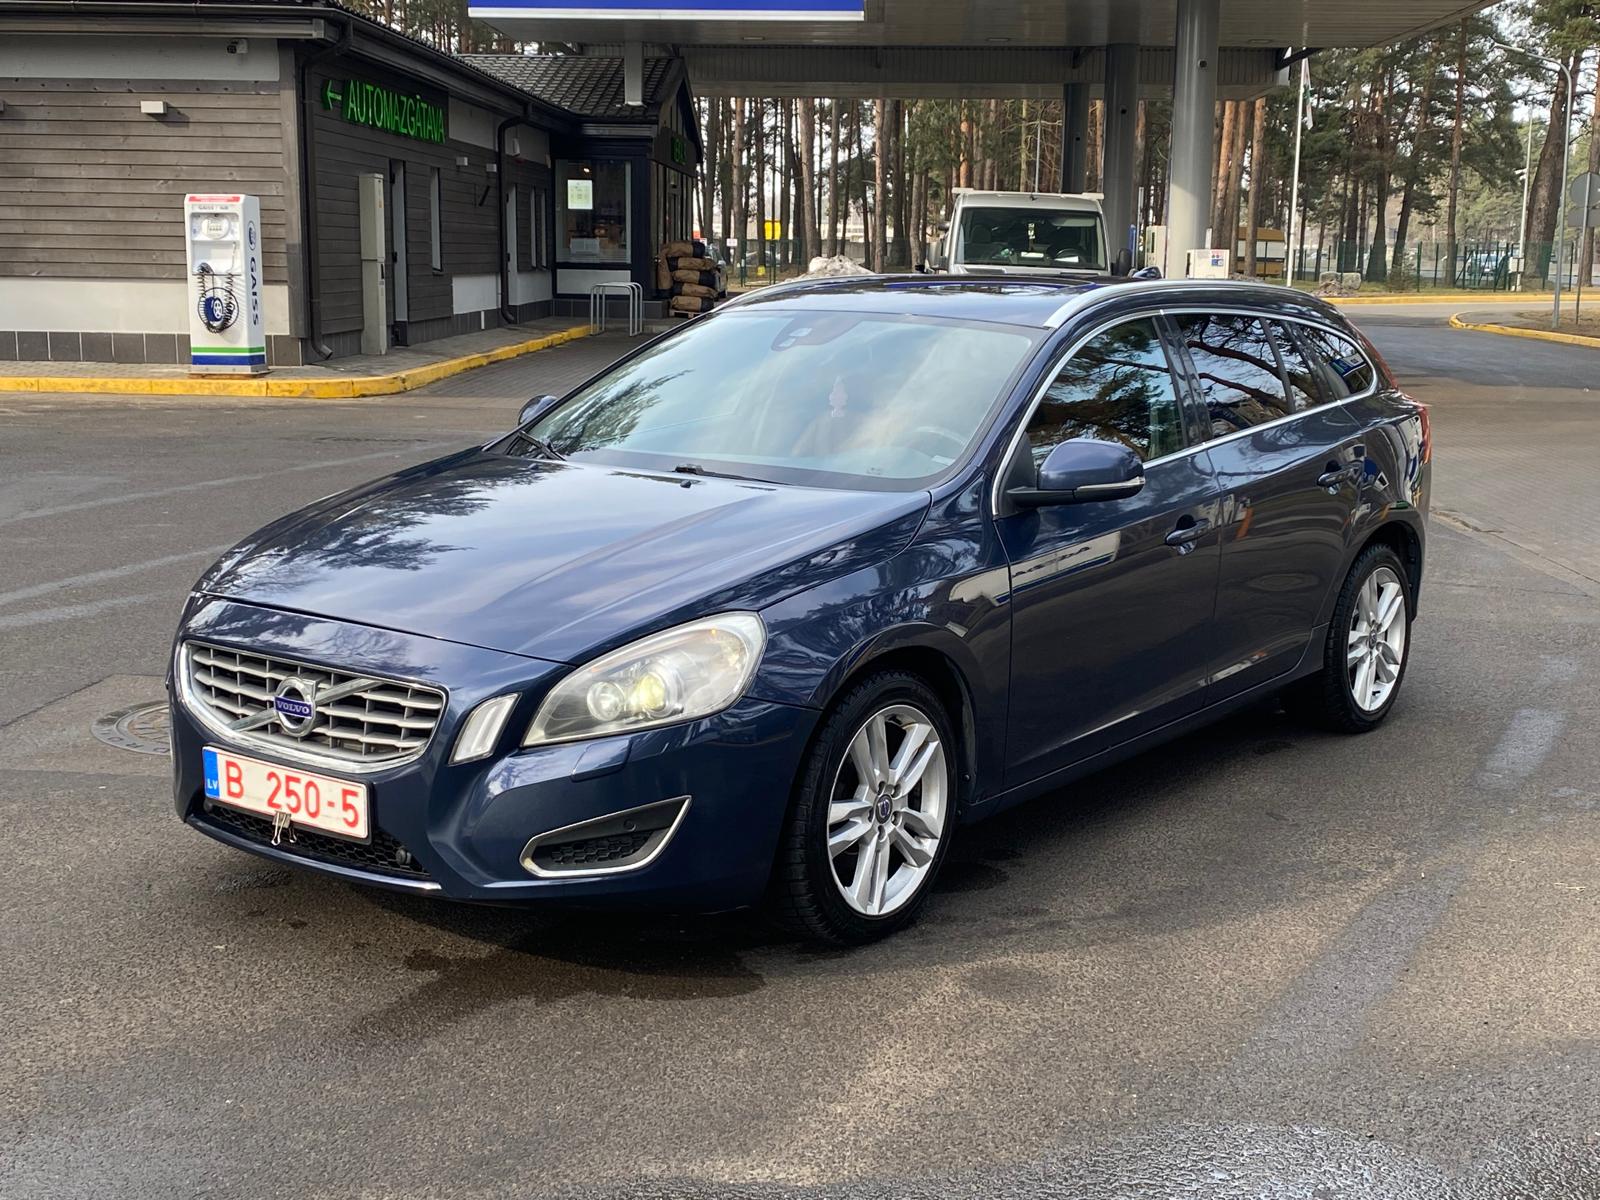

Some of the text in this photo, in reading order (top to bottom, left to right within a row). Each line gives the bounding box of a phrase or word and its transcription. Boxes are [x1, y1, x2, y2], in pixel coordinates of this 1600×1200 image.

[347, 79, 446, 144] AUTOMAZGĀTAVA
[250, 257, 259, 326] GAISS
[276, 700, 310, 714] VOLVO
[207, 778, 219, 790] LV
[225, 759, 360, 828] B 250-5
